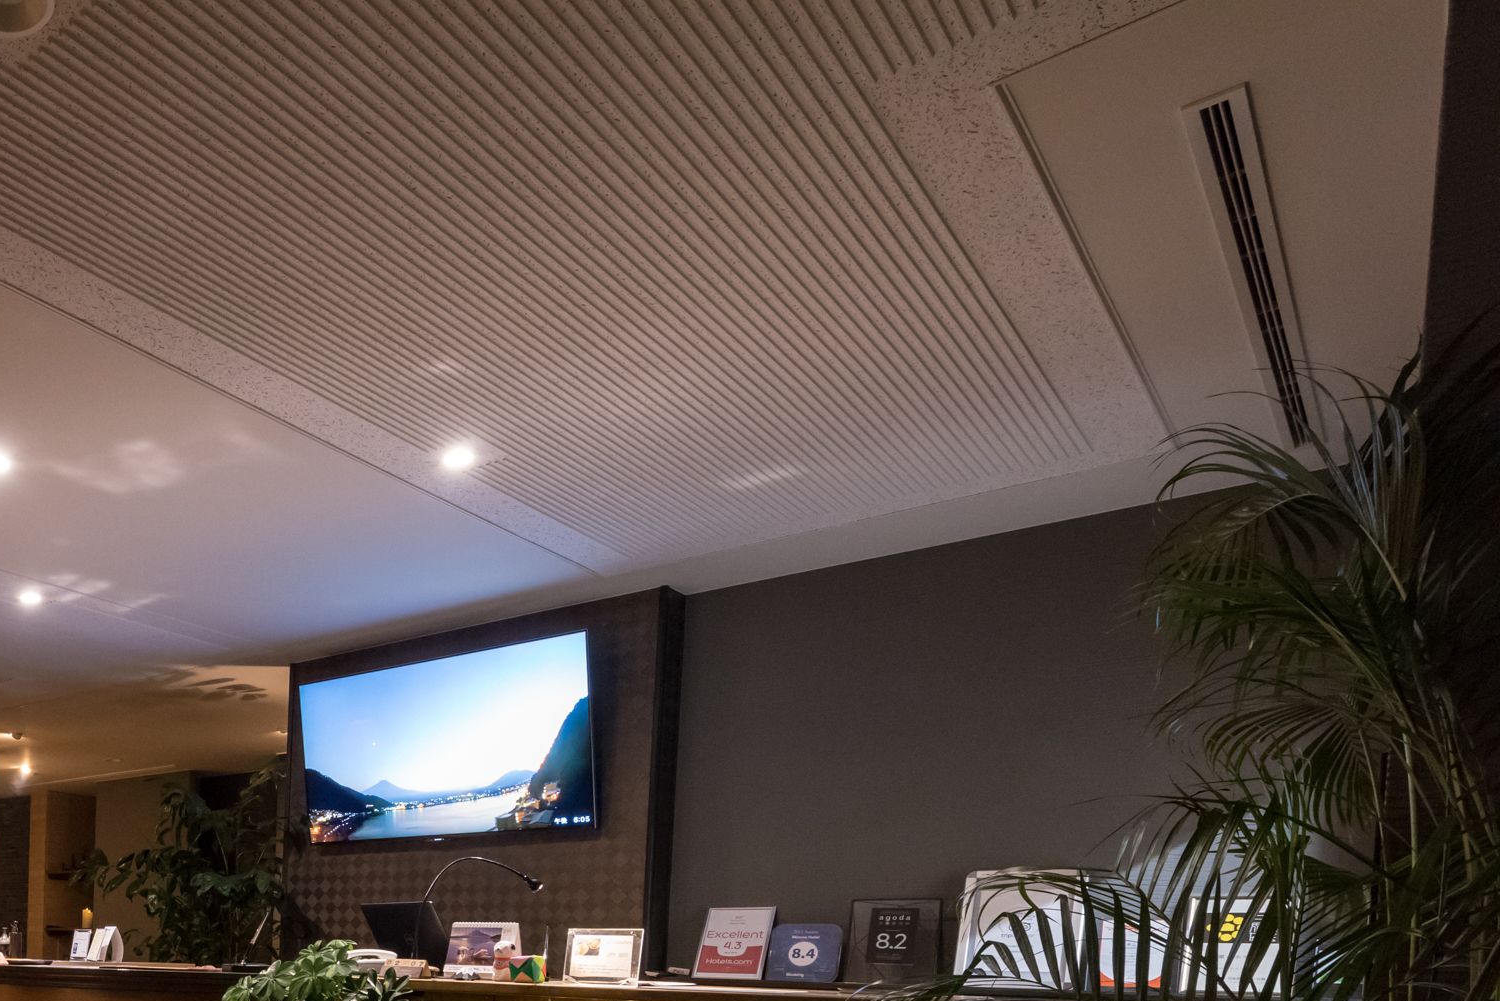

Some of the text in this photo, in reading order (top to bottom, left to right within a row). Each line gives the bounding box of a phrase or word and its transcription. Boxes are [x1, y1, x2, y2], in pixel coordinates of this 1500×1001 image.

[706, 930, 764, 939] Excellent
[723, 941, 742, 950] 4.3
[875, 933, 907, 949] 8.2
[791, 948, 815, 959] 8.4
